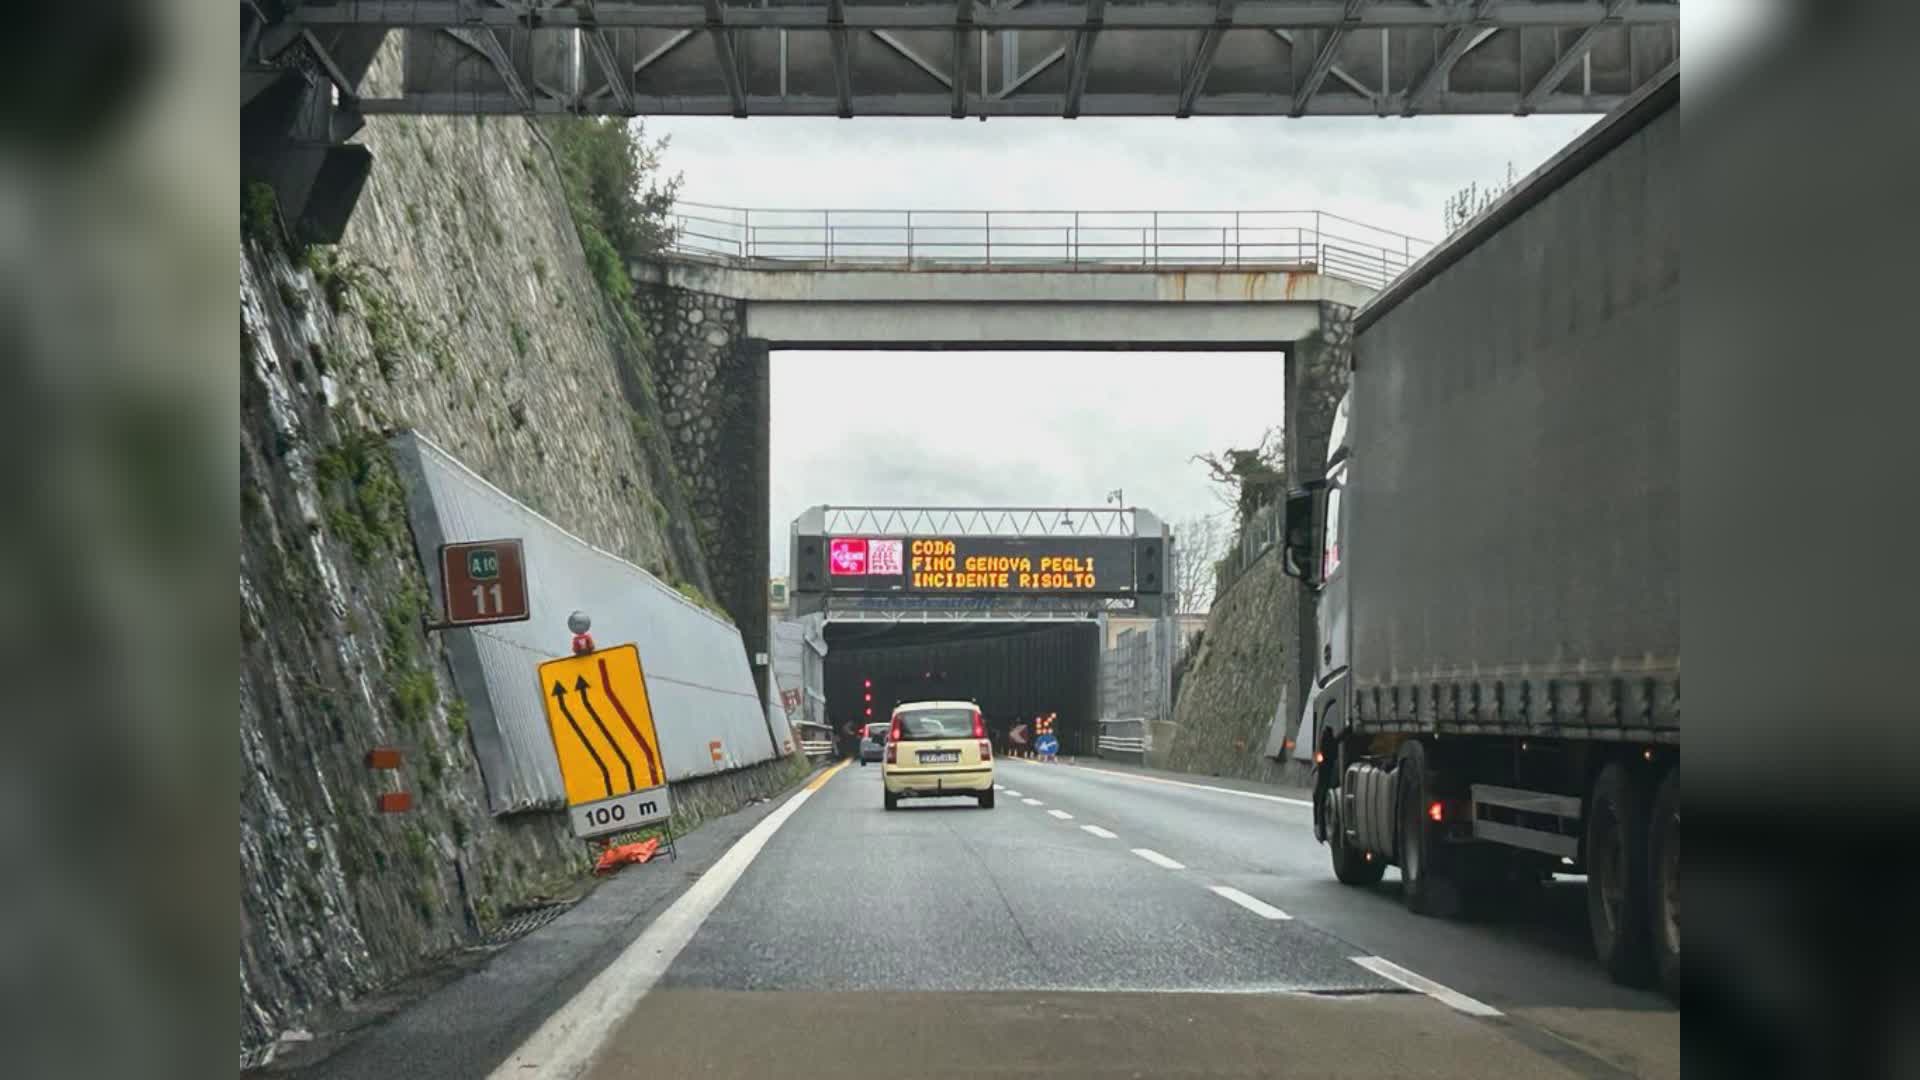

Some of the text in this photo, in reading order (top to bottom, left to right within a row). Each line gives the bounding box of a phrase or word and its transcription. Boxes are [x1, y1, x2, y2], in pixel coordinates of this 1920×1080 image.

[911, 540, 956, 555] CODA
[911, 557, 1095, 572] FINO GENOVA PEGLI
[912, 573, 1096, 589] INCIDENTE RISOLTO
[472, 584, 503, 614] 11
[585, 801, 657, 828] 100 m
